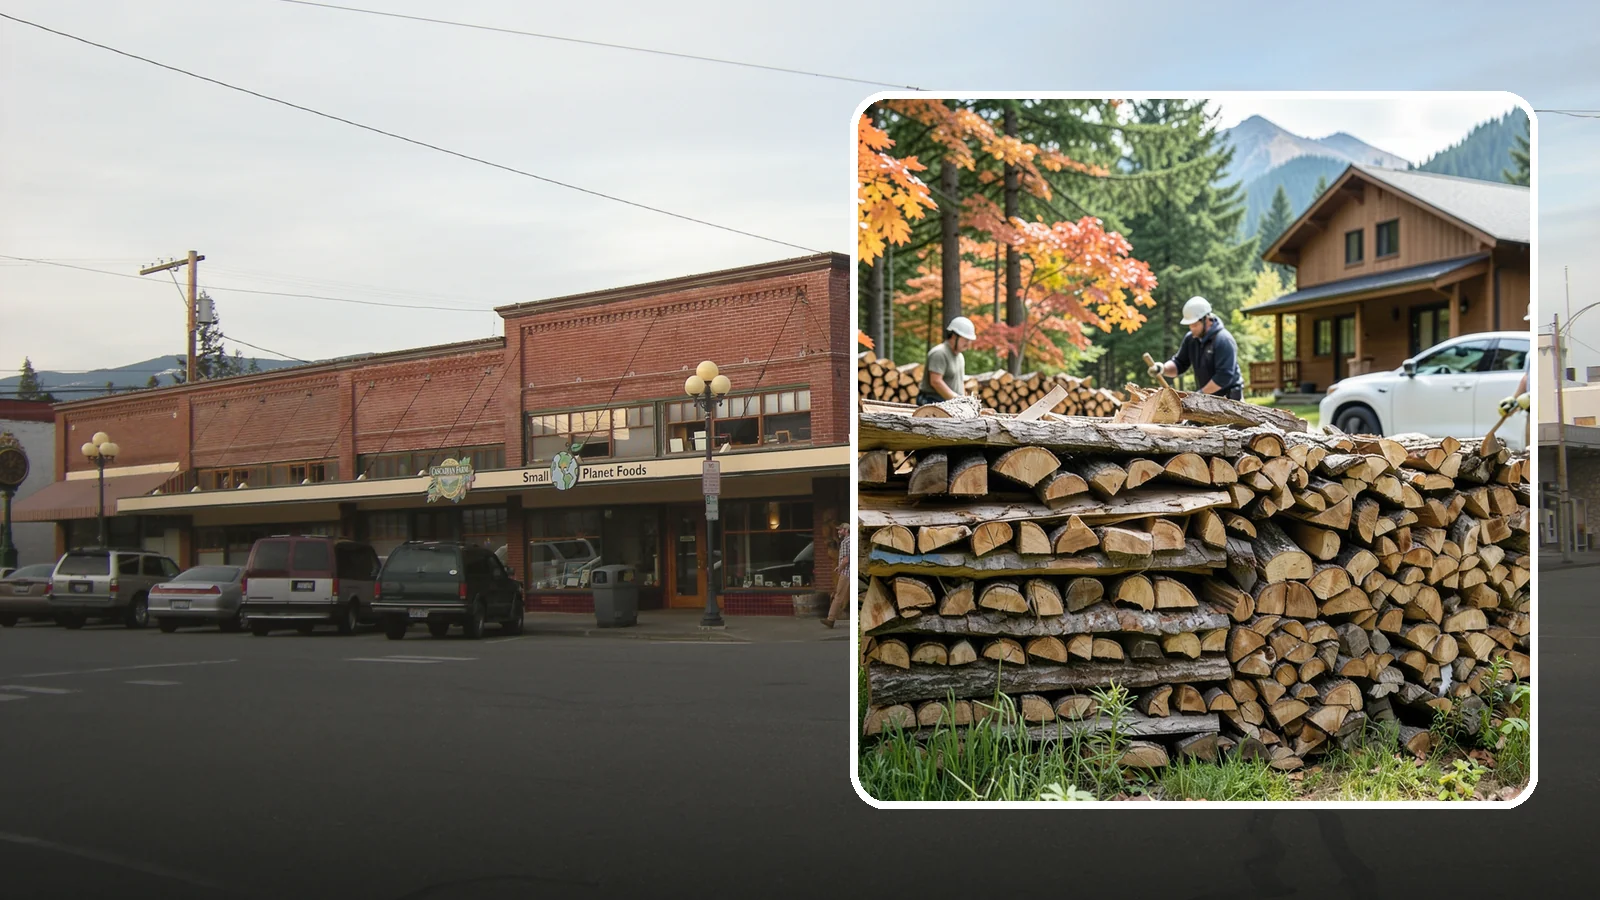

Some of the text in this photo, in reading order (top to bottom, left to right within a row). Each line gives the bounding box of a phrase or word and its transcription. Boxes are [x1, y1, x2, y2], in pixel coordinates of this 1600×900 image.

[431, 466, 469, 475] CASCADIAN FARM
[523, 465, 647, 482] Small Planet Foods
